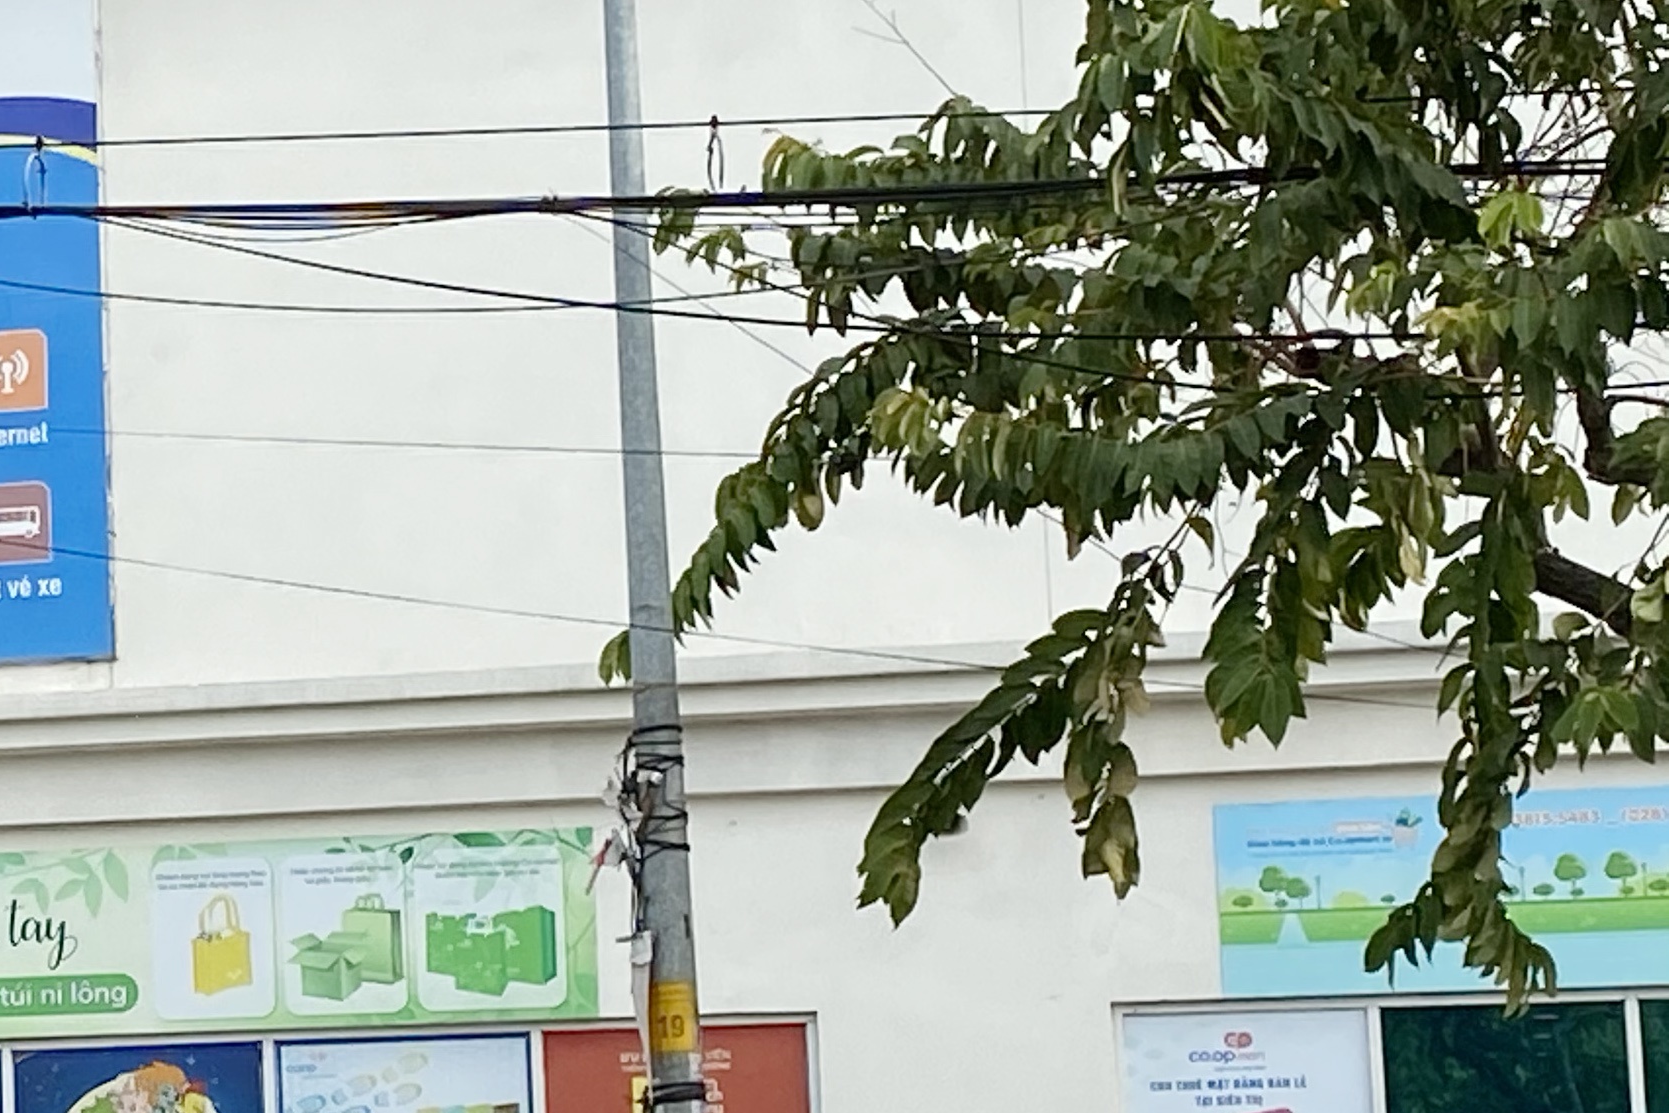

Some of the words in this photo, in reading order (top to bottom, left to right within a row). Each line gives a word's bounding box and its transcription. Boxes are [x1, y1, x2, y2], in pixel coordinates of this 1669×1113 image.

[7, 574, 32, 599] vé
[37, 577, 63, 597] xe
[5, 898, 79, 970] tay
[0, 980, 34, 1007] túi
[40, 984, 64, 1006] ni
[69, 980, 128, 1010] lông
[657, 1014, 685, 1040] 19
